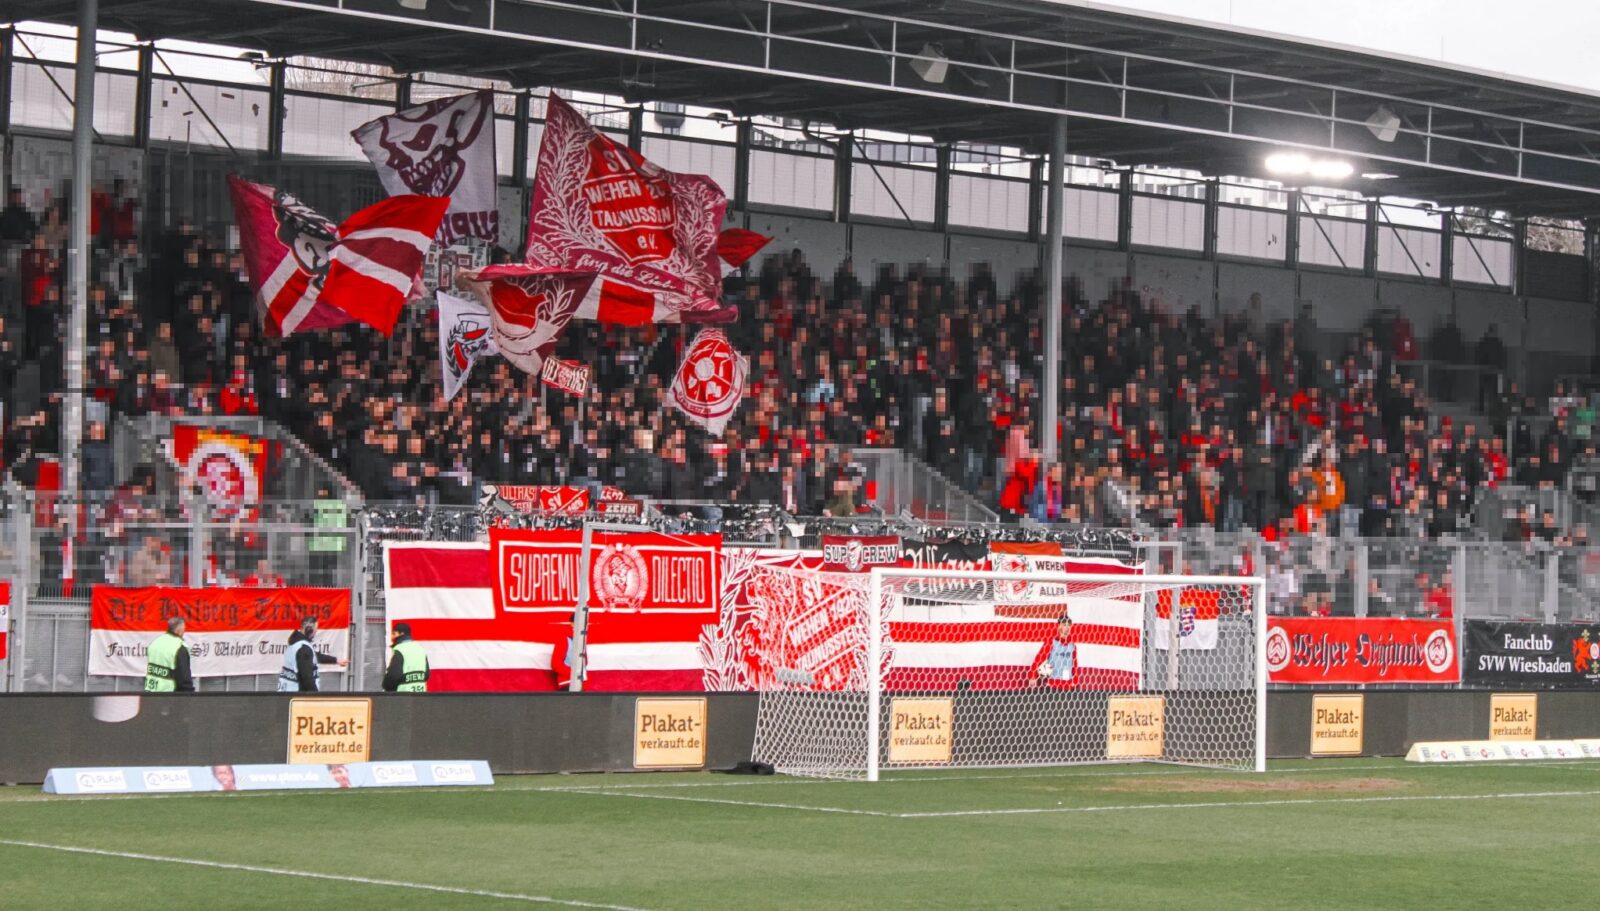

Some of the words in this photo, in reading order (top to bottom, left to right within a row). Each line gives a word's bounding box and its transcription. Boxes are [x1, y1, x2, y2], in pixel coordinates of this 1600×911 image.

[586, 181, 641, 205] WEHEN
[547, 492, 563, 512] SV
[861, 544, 898, 563] CREW
[1035, 561, 1065, 572] WEHEN
[652, 556, 705, 603] DILECTIO
[108, 598, 145, 622] Die
[106, 642, 148, 658] Fanclu
[1503, 633, 1553, 651] Fanclub
[1478, 655, 1507, 672] SVW
[1508, 656, 1572, 673] Wiesbaden
[641, 715, 701, 732] Plakat-
[895, 713, 947, 730] Plakat-
[1112, 710, 1159, 727] Plakat-
[1316, 709, 1359, 724] Plakat-
[1494, 708, 1533, 722] Plakat-
[296, 716, 364, 736] Plakat-
[1315, 729, 1359, 738] verkauft.de
[1493, 726, 1532, 736] verkauft.de
[295, 741, 363, 753] verkauft.de
[640, 738, 700, 749] verkauft.de
[894, 735, 947, 746] verkauft.de
